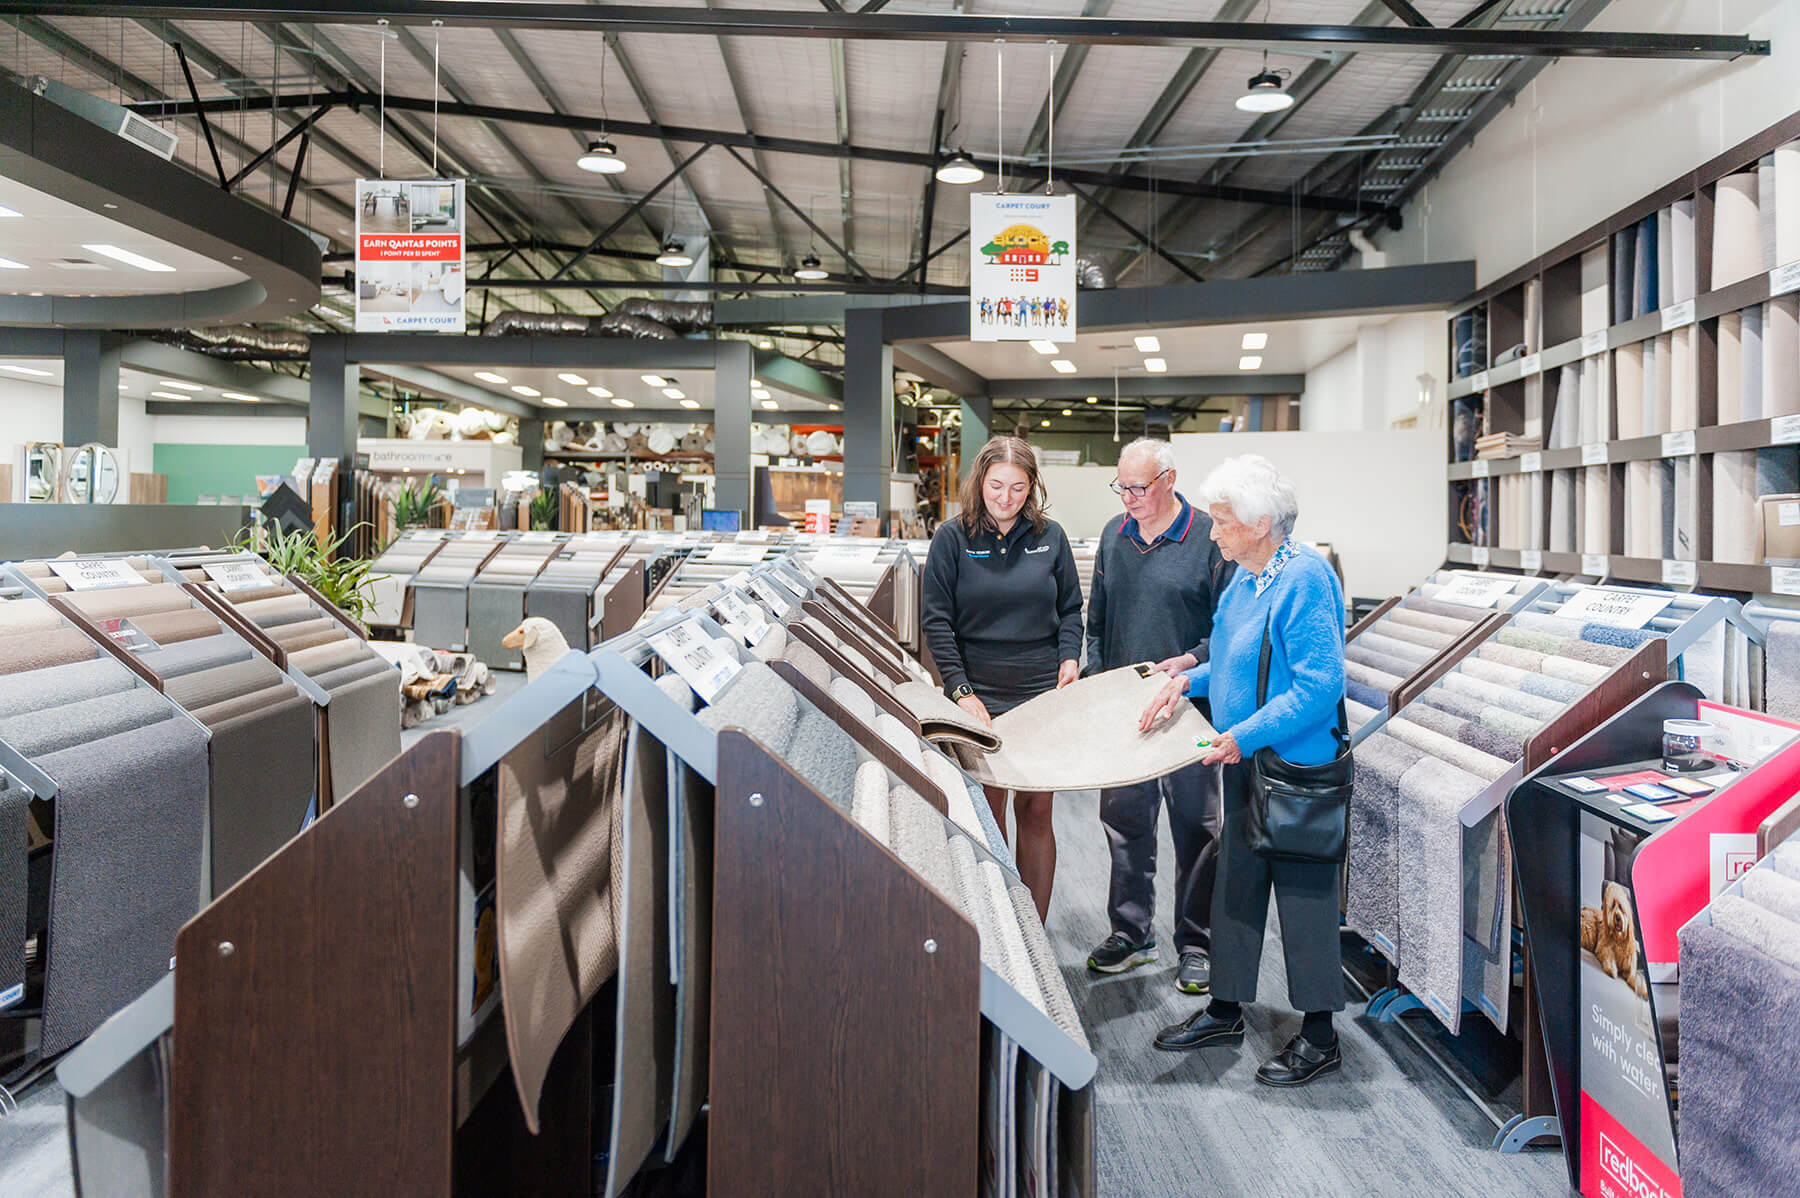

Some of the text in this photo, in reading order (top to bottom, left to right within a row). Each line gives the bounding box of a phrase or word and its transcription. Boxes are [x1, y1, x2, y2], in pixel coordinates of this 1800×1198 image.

[363, 239, 458, 250] EARN QANTAS POINTS
[80, 569, 120, 580] COUNTRY
[1603, 592, 1640, 604] CARPET
[1586, 602, 1633, 615] COUNTRY
[1592, 1003, 1631, 1053] Simply
[1591, 1032, 1660, 1099] with water.
